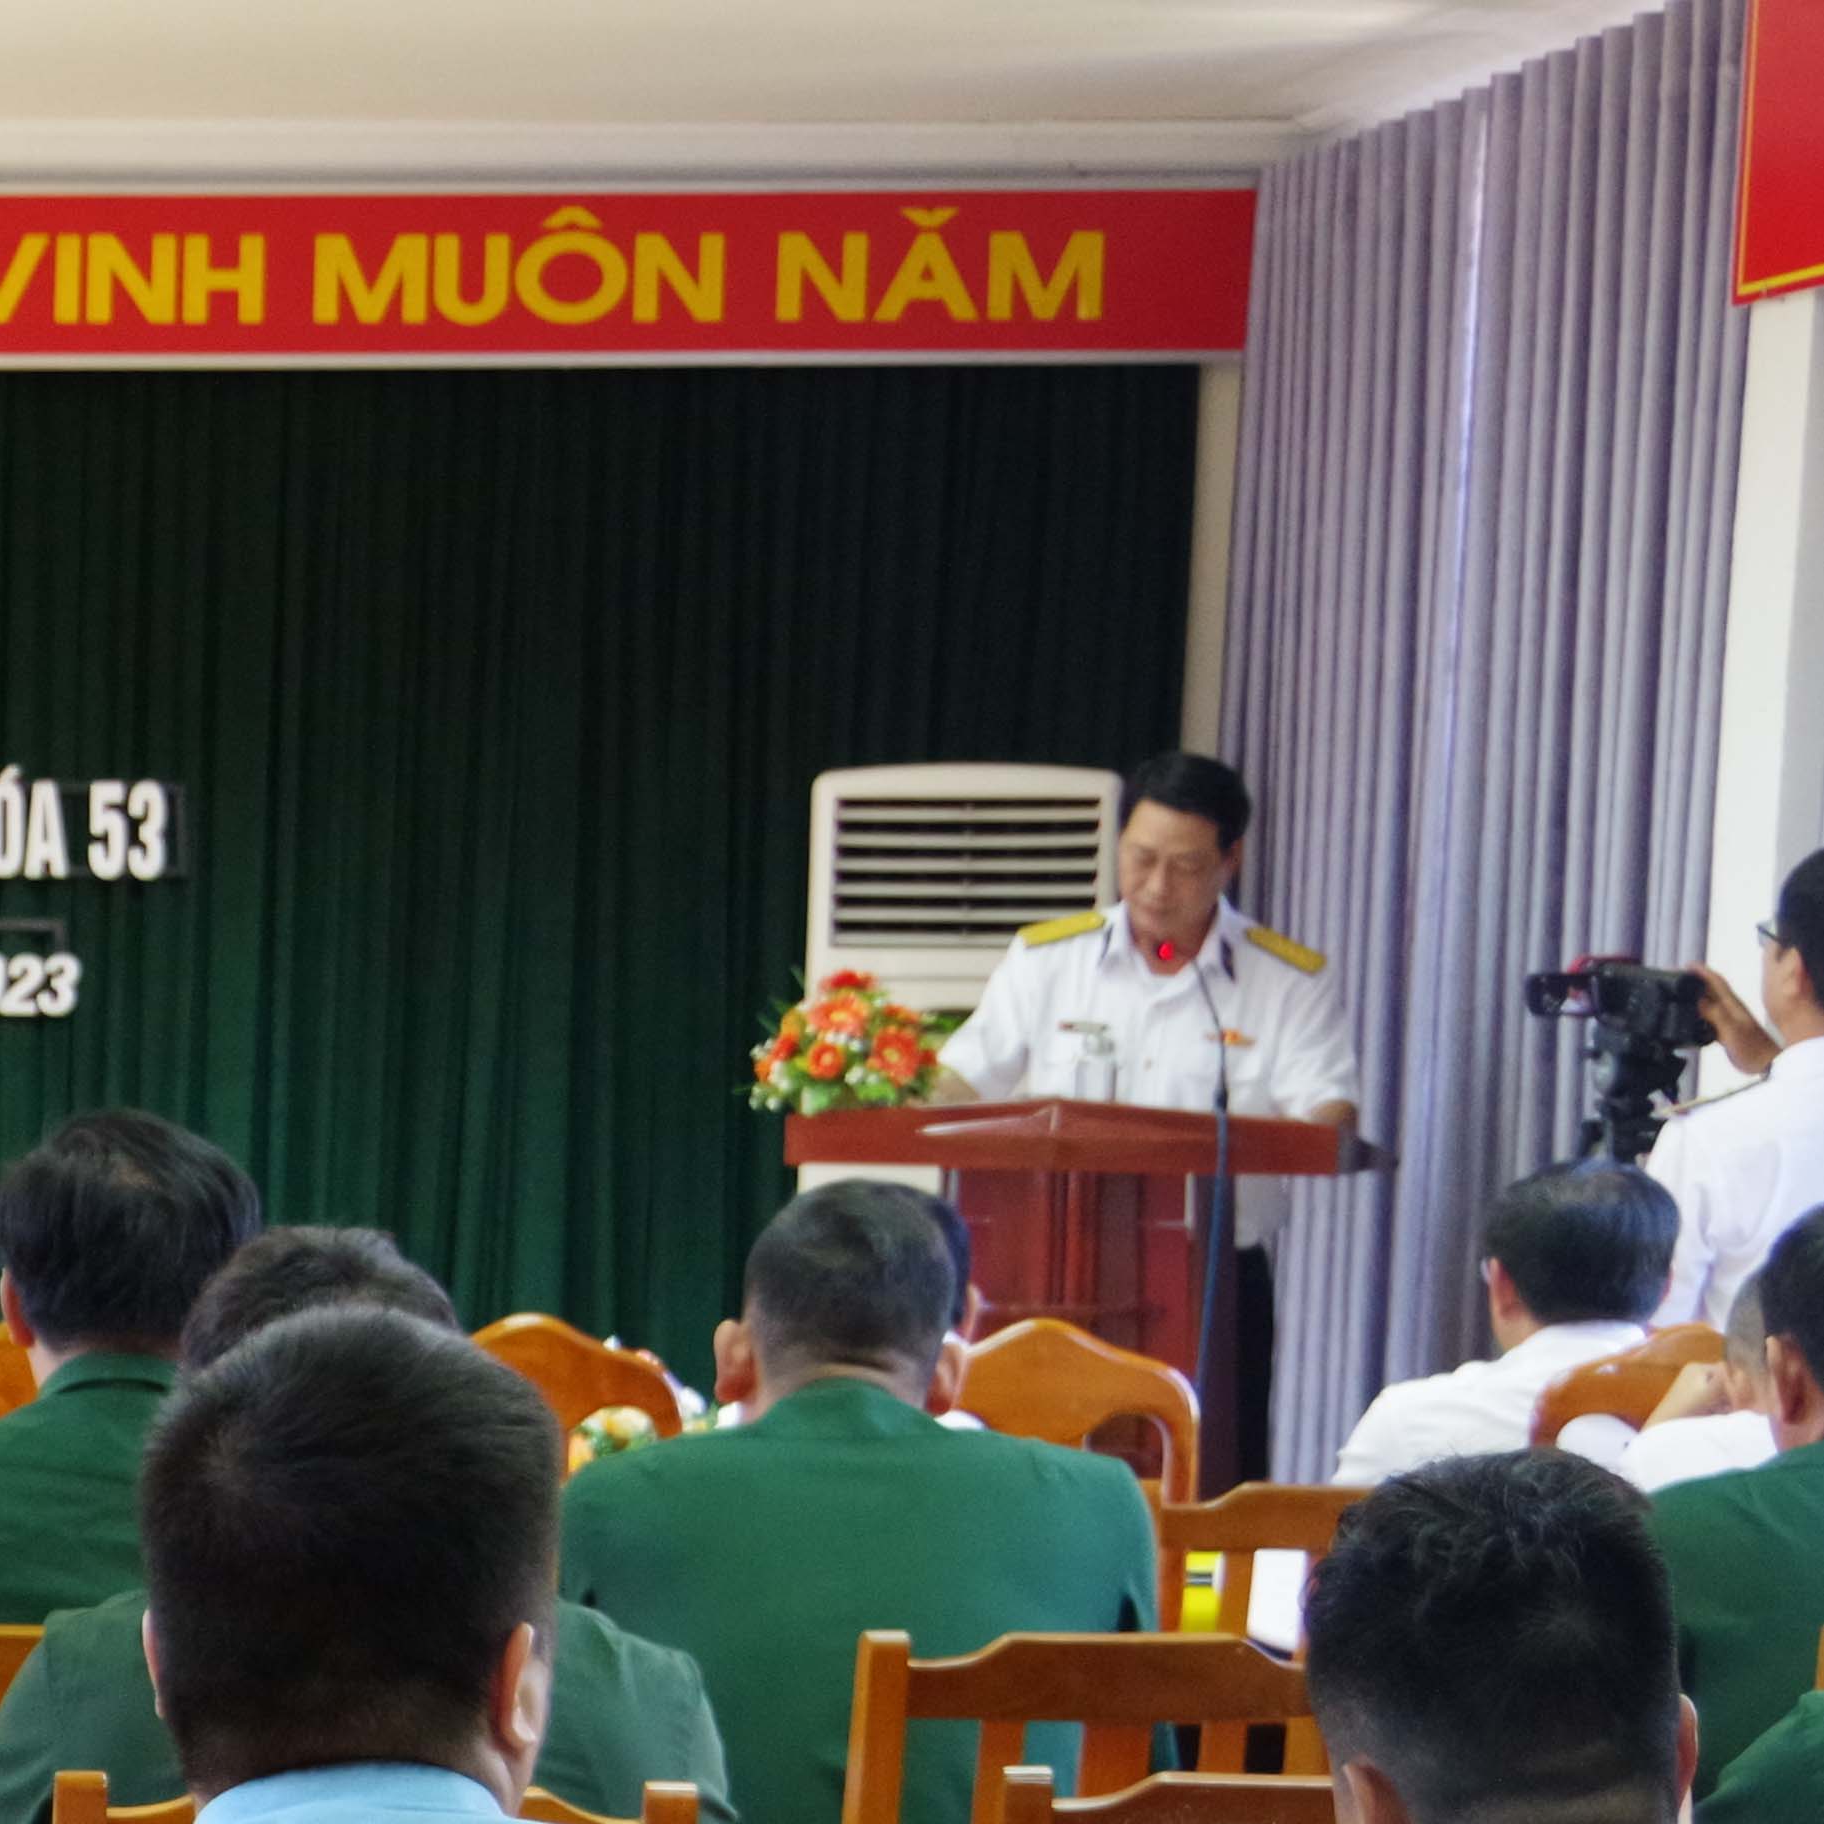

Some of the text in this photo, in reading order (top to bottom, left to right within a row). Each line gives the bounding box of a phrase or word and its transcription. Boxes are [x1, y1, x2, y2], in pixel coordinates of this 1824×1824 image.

[313, 206, 724, 324] MUÔN
[776, 208, 1104, 320] NĂM
[87, 779, 167, 879] 53
